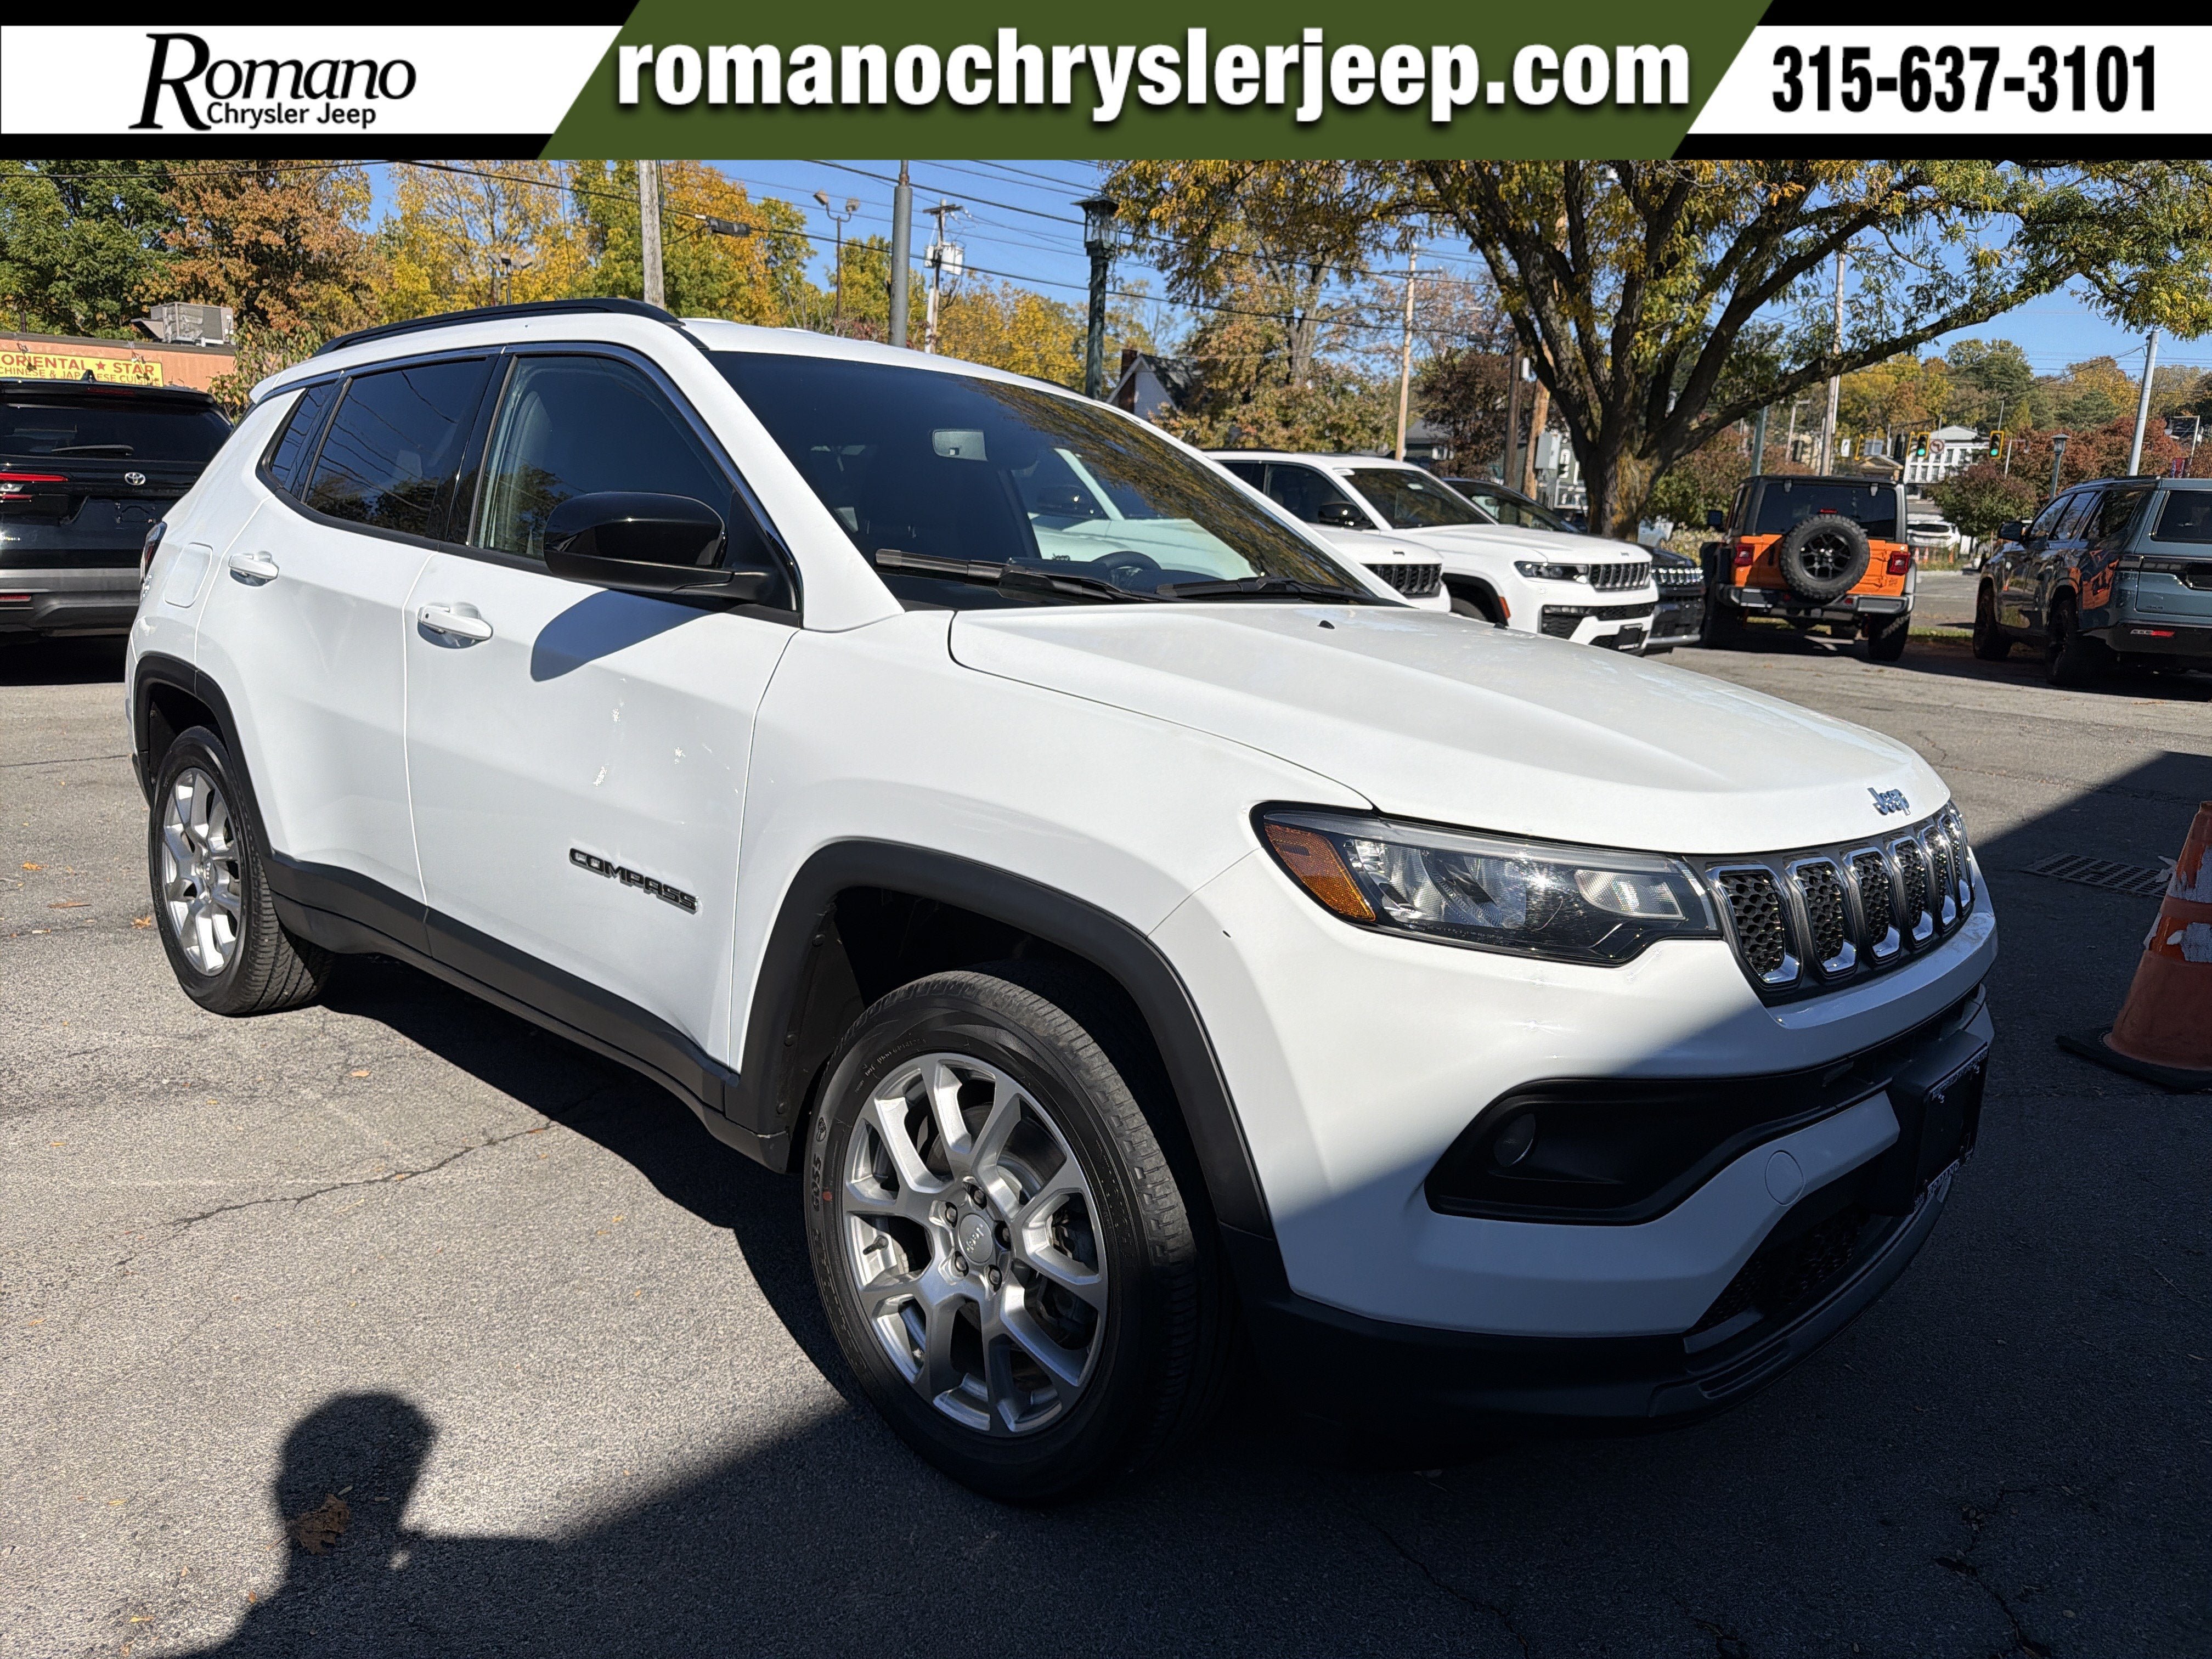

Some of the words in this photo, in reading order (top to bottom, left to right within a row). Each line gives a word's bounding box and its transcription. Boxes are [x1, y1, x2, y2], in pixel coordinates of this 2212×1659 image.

[1, 354, 88, 370] ORIENTAL
[113, 362, 154, 375] STAR
[50, 370, 56, 379] &
[61, 370, 116, 382] JAPESE
[1867, 787, 1911, 816] Jeep
[569, 848, 698, 915] COMPASS
